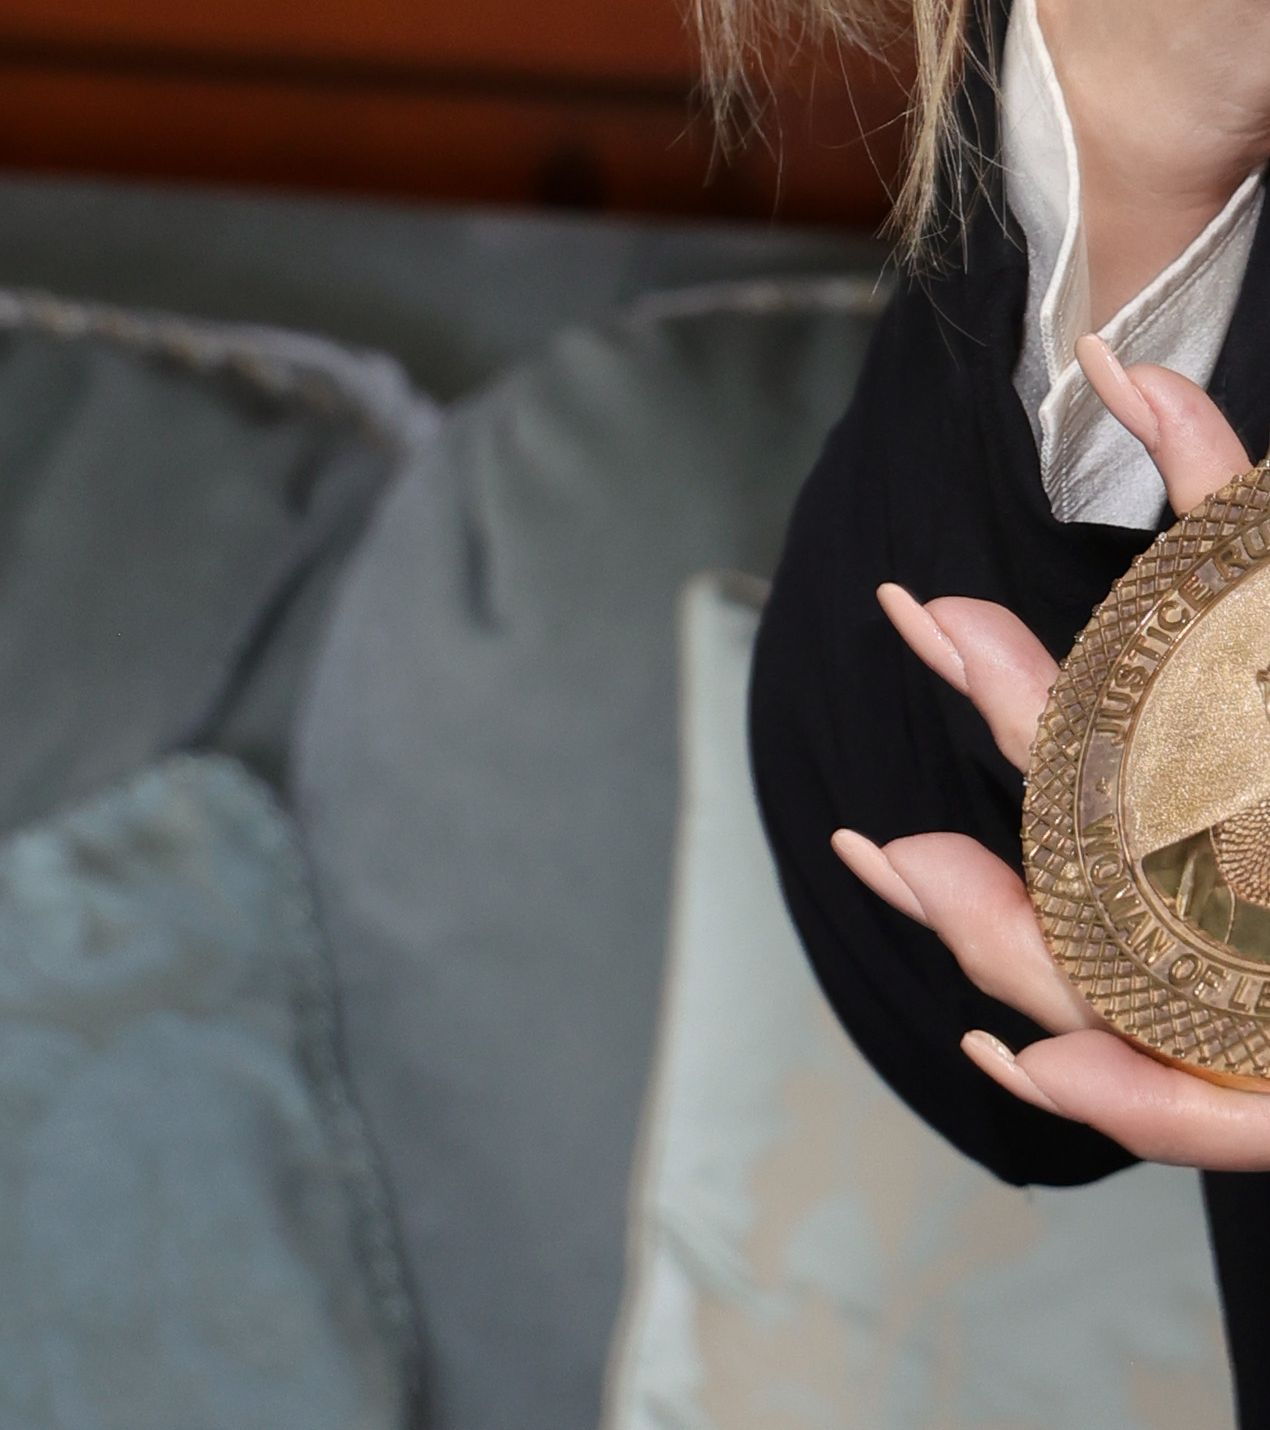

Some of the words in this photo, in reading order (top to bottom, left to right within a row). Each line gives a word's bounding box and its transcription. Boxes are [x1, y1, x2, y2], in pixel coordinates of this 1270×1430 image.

[1096, 573, 1215, 745] JUSTICE
[1081, 814, 1175, 966] WOMAN
[1168, 953, 1228, 999] OF
